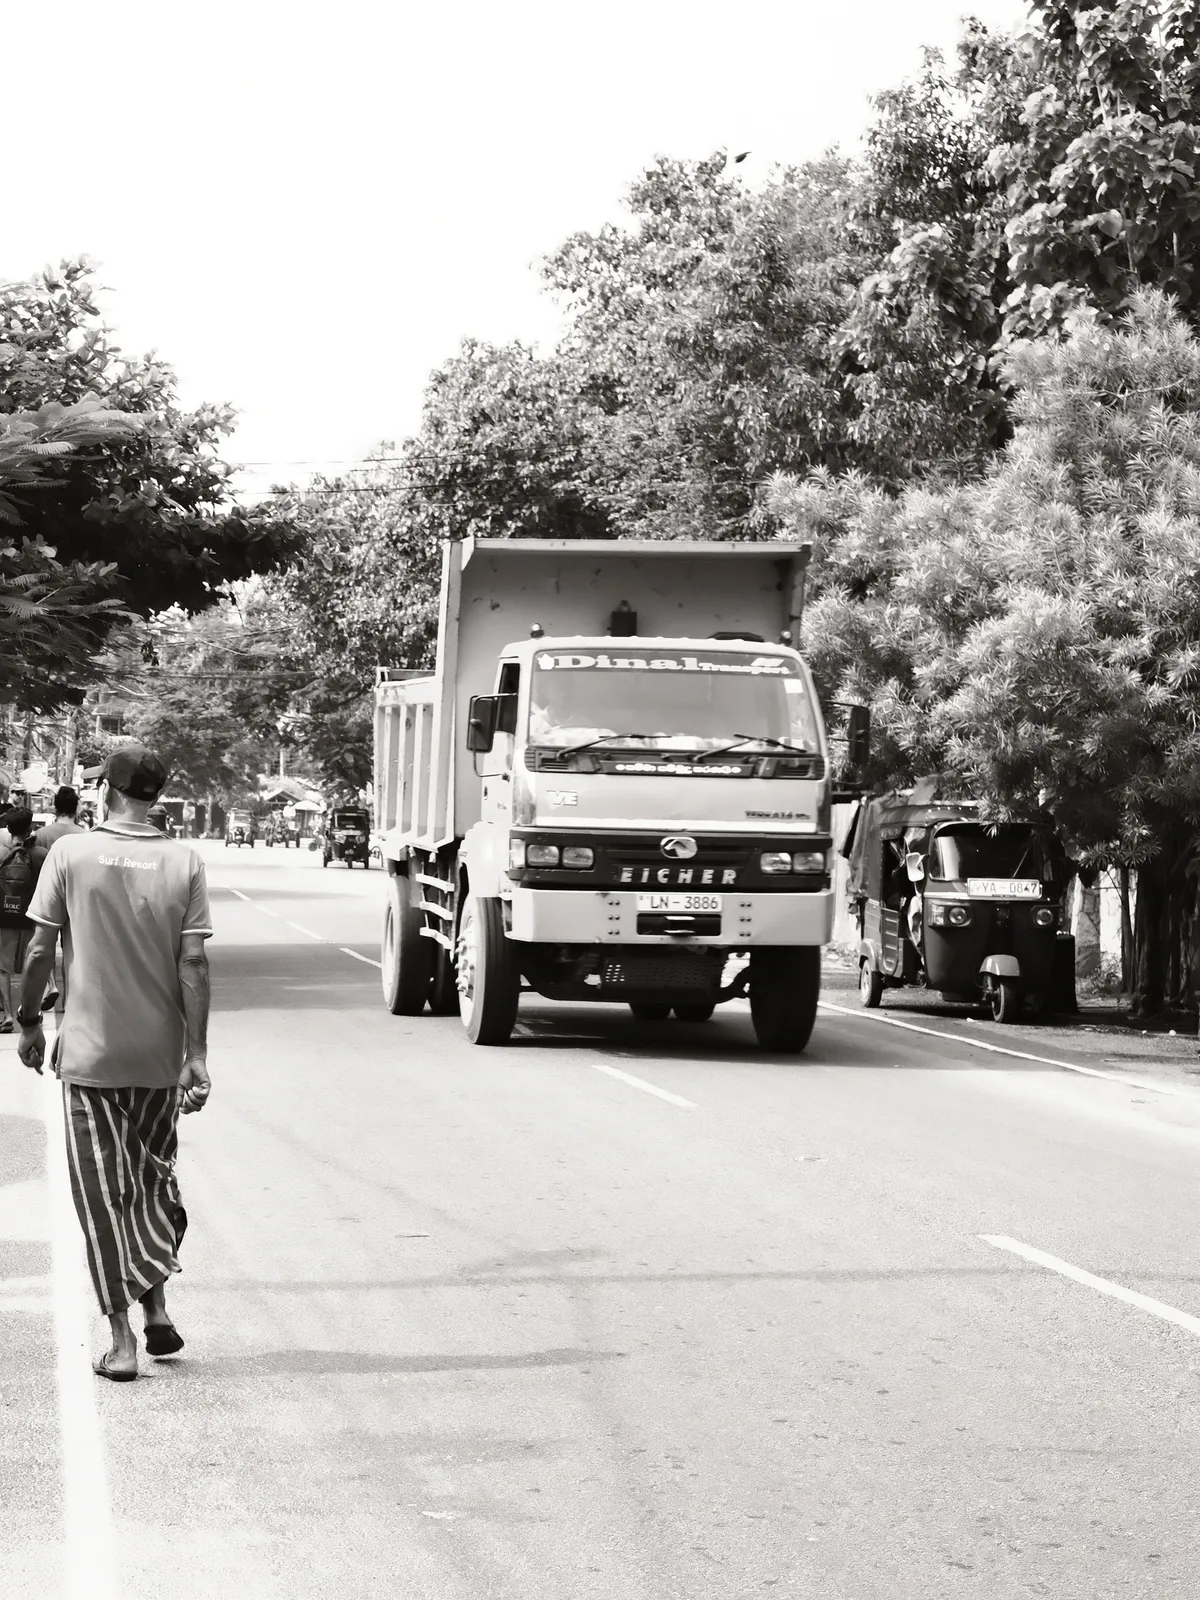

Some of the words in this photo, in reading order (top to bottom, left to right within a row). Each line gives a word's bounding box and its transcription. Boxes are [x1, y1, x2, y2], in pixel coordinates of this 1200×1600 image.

[553, 655, 700, 671] Dinal
[698, 662, 790, 675] Transport
[98, 854, 120, 866] Surf
[123, 857, 157, 870] Resort
[619, 867, 737, 885] EICHER
